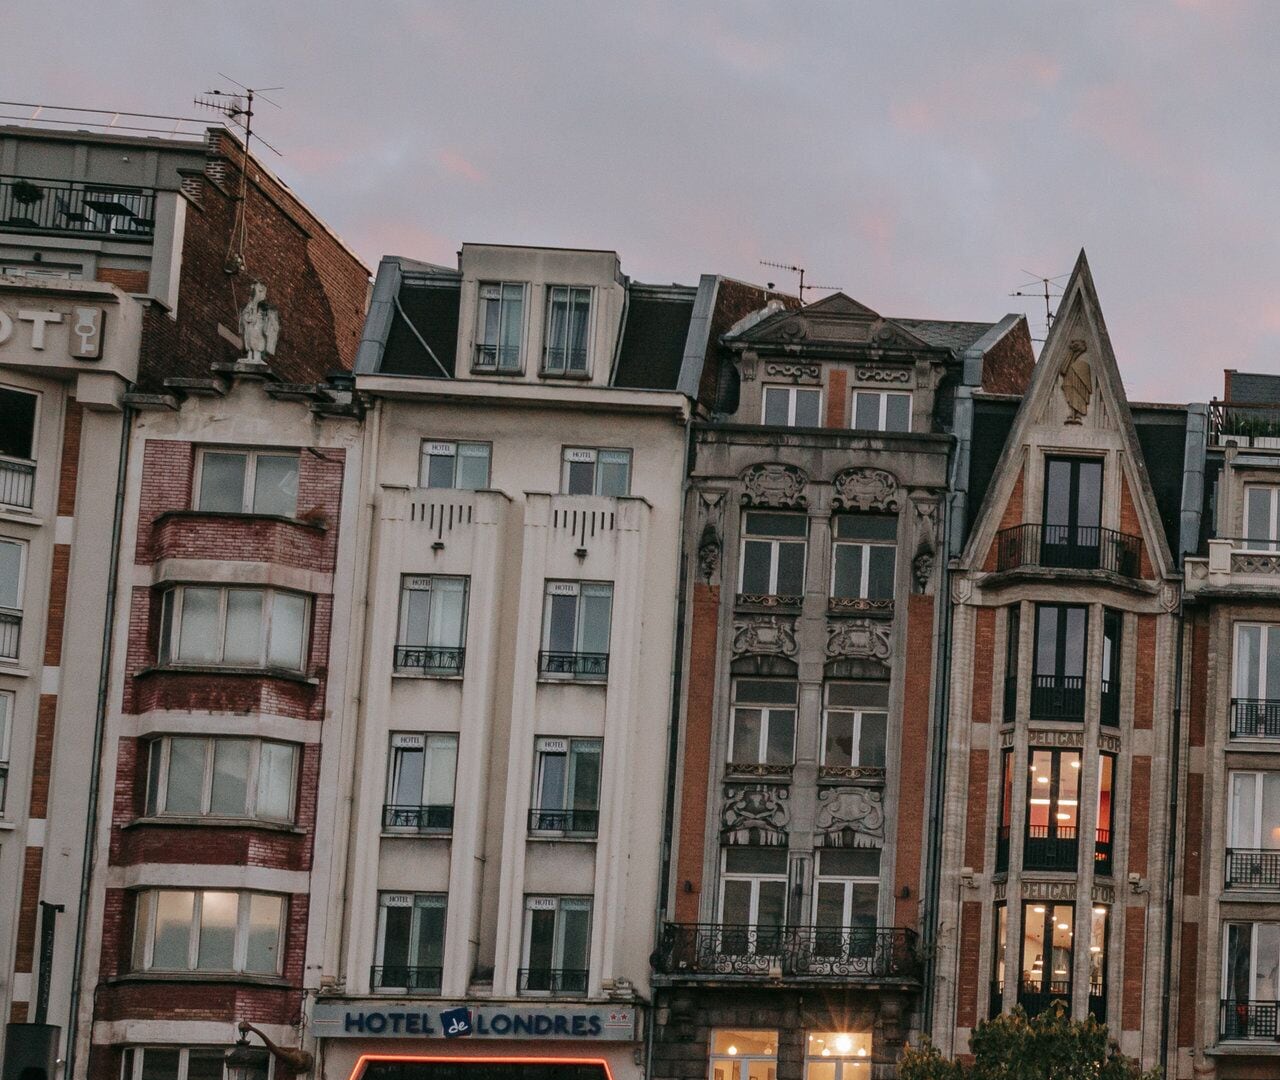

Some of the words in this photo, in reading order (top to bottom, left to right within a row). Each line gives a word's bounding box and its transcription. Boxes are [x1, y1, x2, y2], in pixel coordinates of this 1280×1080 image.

[553, 584, 574, 593] HOTEL
[399, 736, 420, 745] HOTEL
[543, 741, 564, 750] HOTEL
[388, 895, 409, 904] HOTEL
[533, 898, 554, 908] HOTEL
[344, 1012, 434, 1034] HOTEL
[448, 1018, 469, 1034] de
[477, 1014, 602, 1036] LONDRES
